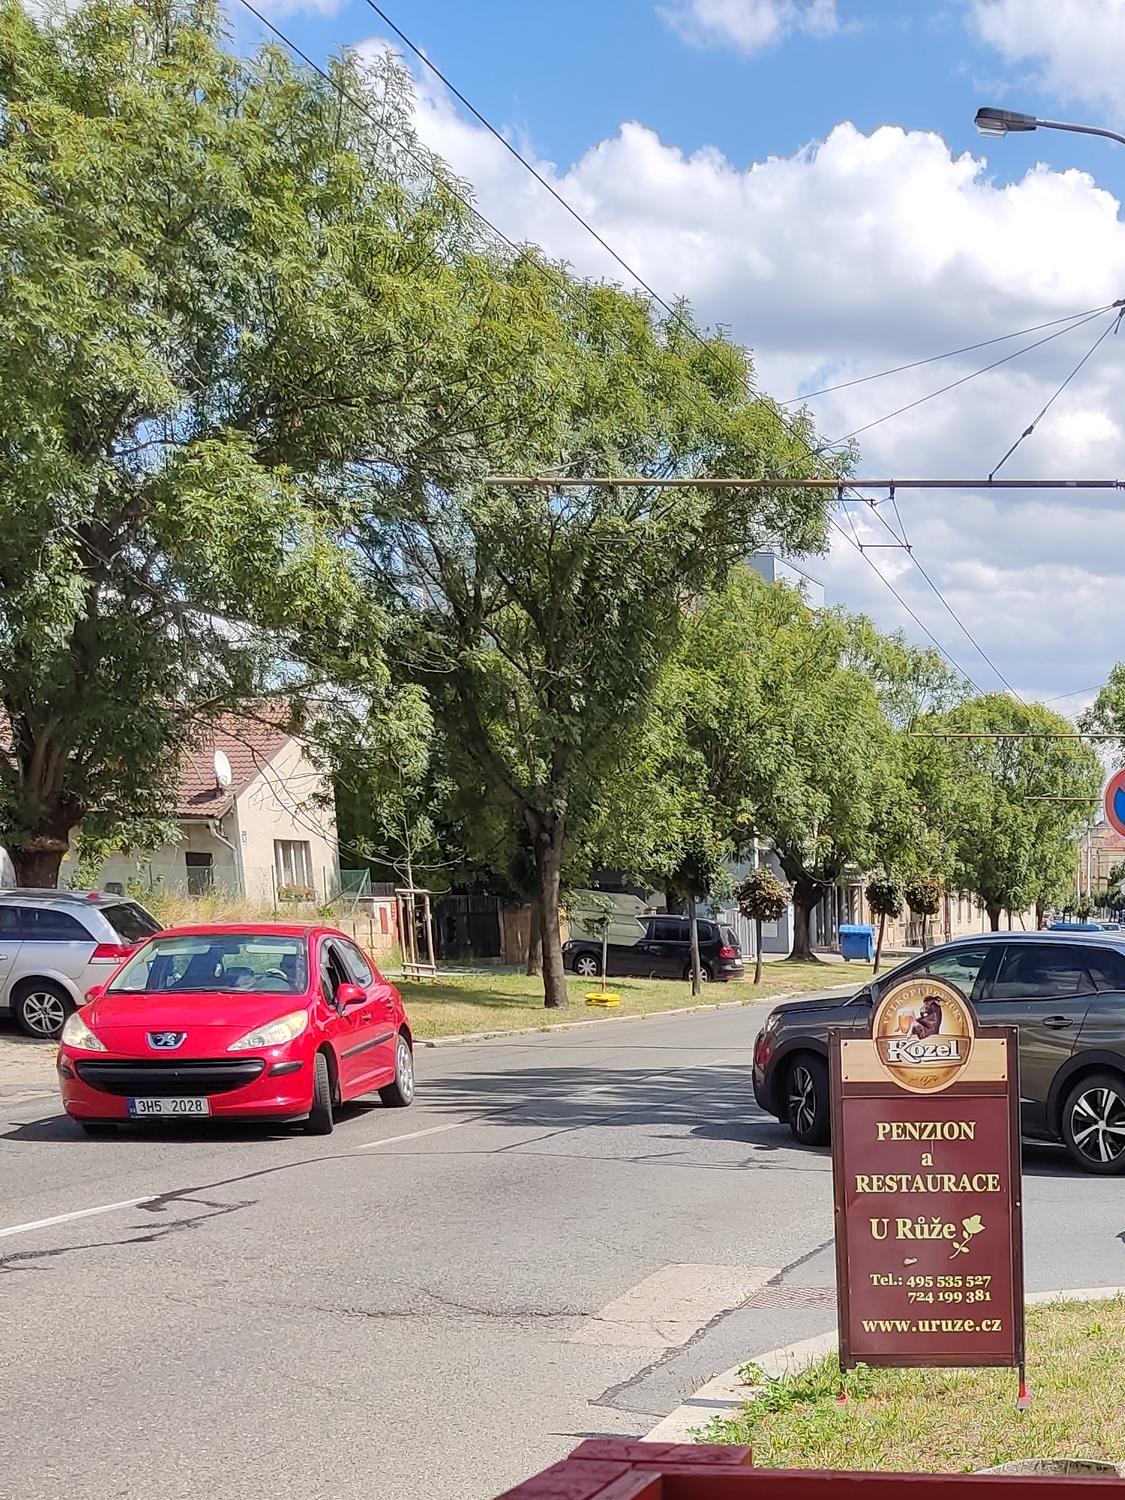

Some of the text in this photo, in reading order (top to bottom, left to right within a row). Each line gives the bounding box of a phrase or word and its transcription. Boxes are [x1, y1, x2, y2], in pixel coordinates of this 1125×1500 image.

[887, 1039, 962, 1064] Kozel
[138, 1099, 203, 1112] 3H5 2028
[876, 1121, 976, 1141] PENZION
[921, 1152, 934, 1167] a
[854, 1173, 1001, 1193] RESTAURACE
[869, 1216, 957, 1240] U Růže
[869, 1272, 992, 1288] Tel.: 495 535 527
[907, 1289, 992, 1304] 724 199 381
[862, 1319, 1002, 1333] www.uruze.cz
